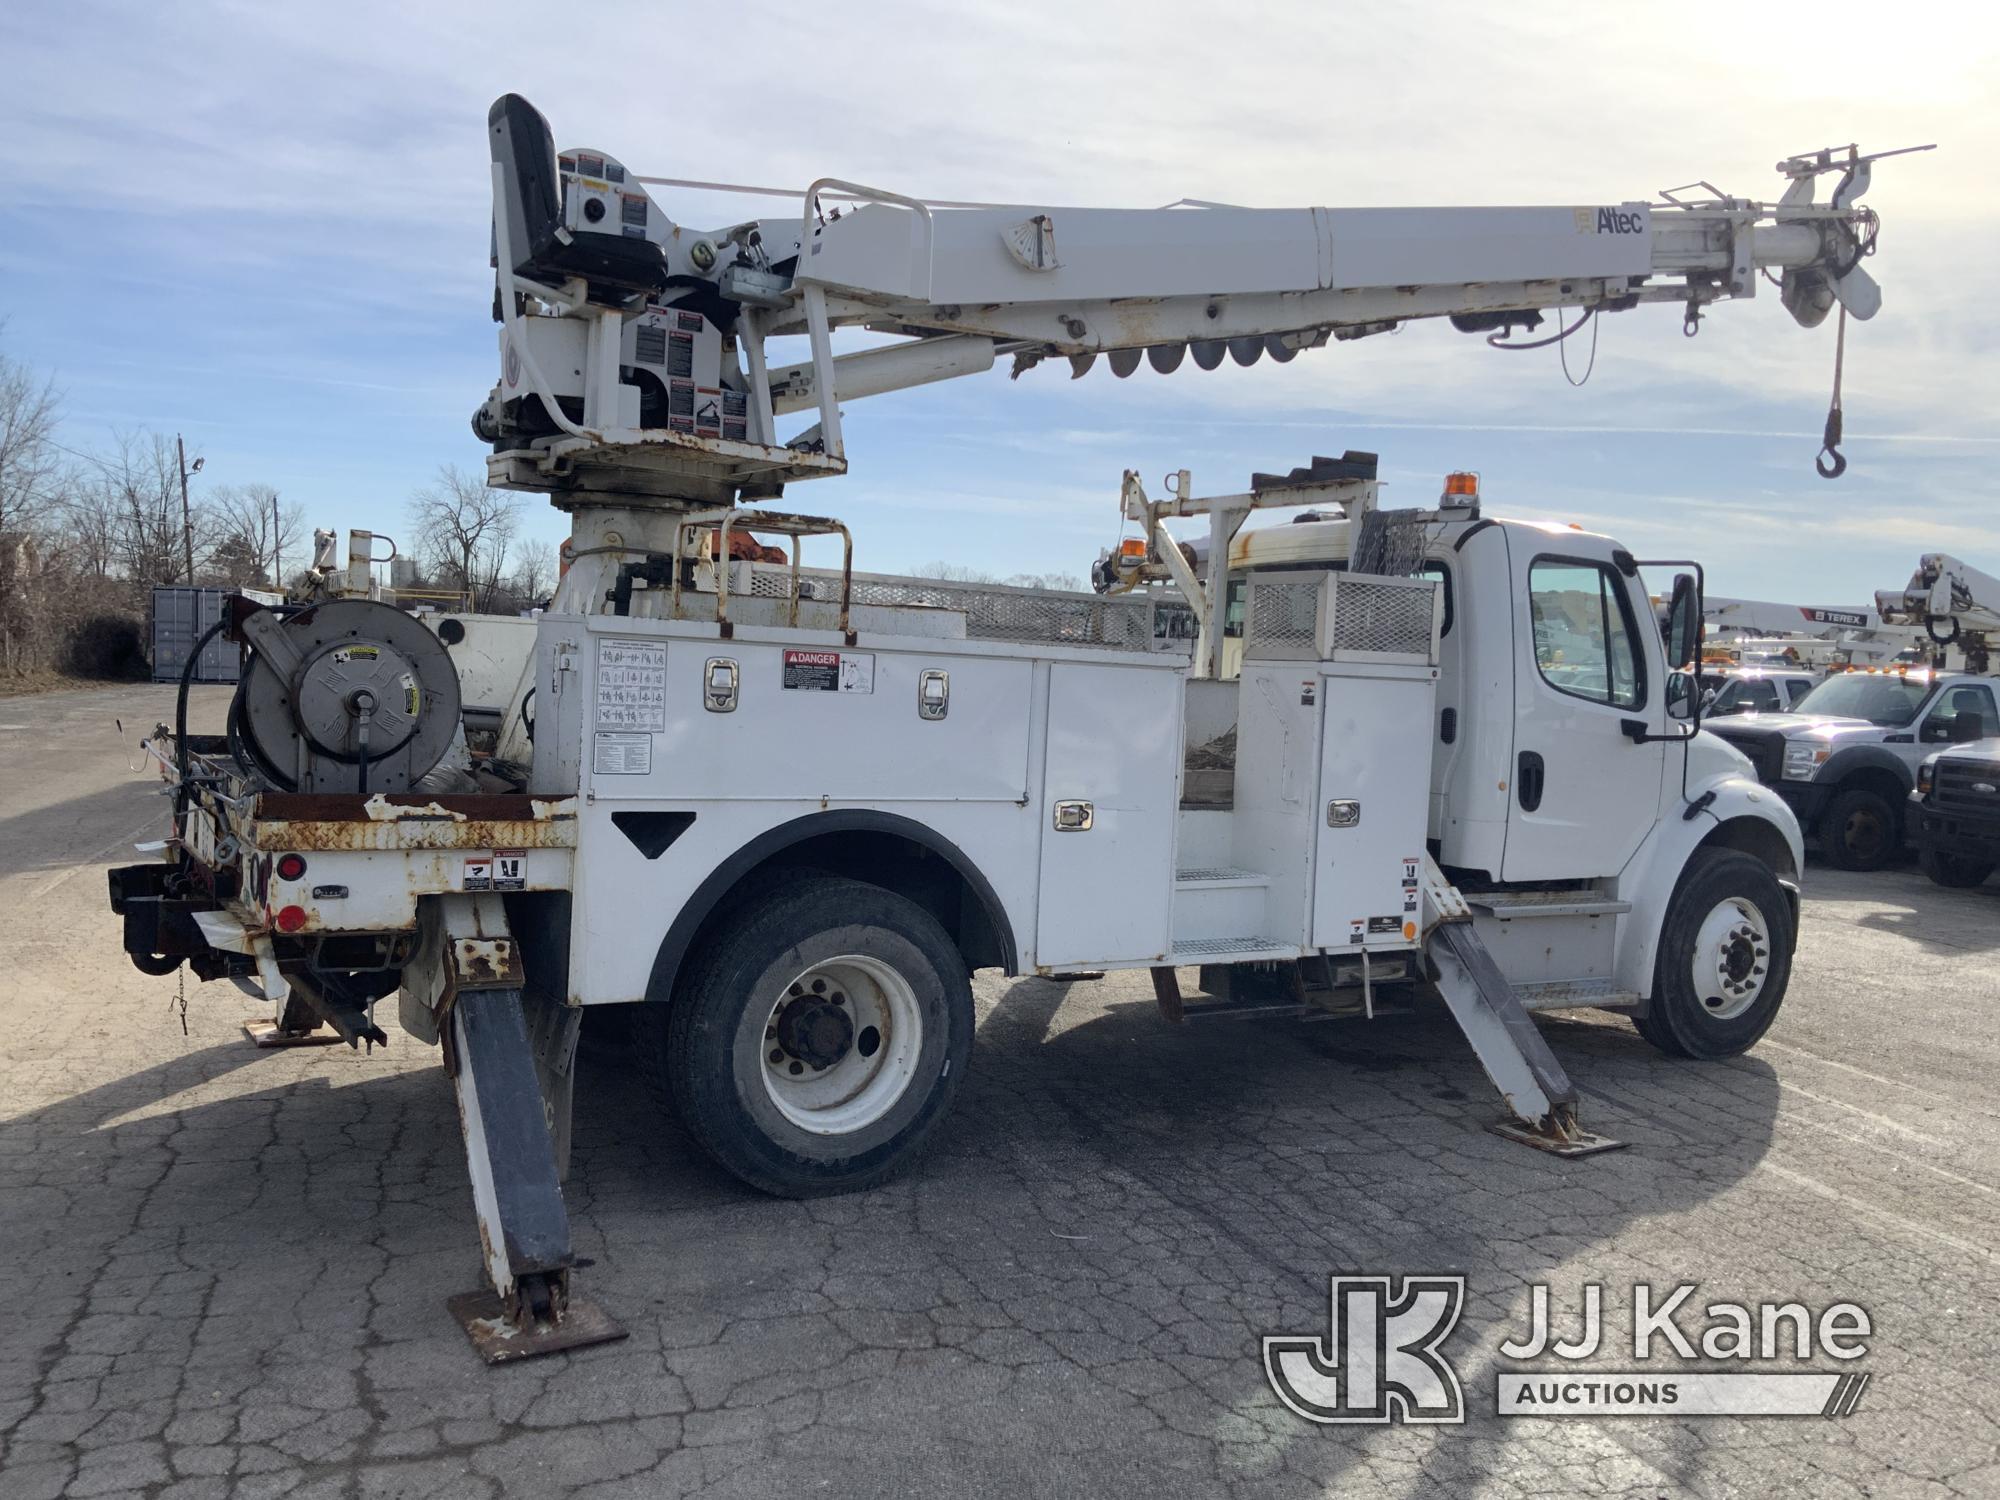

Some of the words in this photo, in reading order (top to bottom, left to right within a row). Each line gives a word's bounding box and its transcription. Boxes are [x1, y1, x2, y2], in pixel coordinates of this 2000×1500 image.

[1597, 207, 1643, 234] Altec
[1827, 612, 1860, 625] TEREX
[798, 653, 836, 665] DANGER
